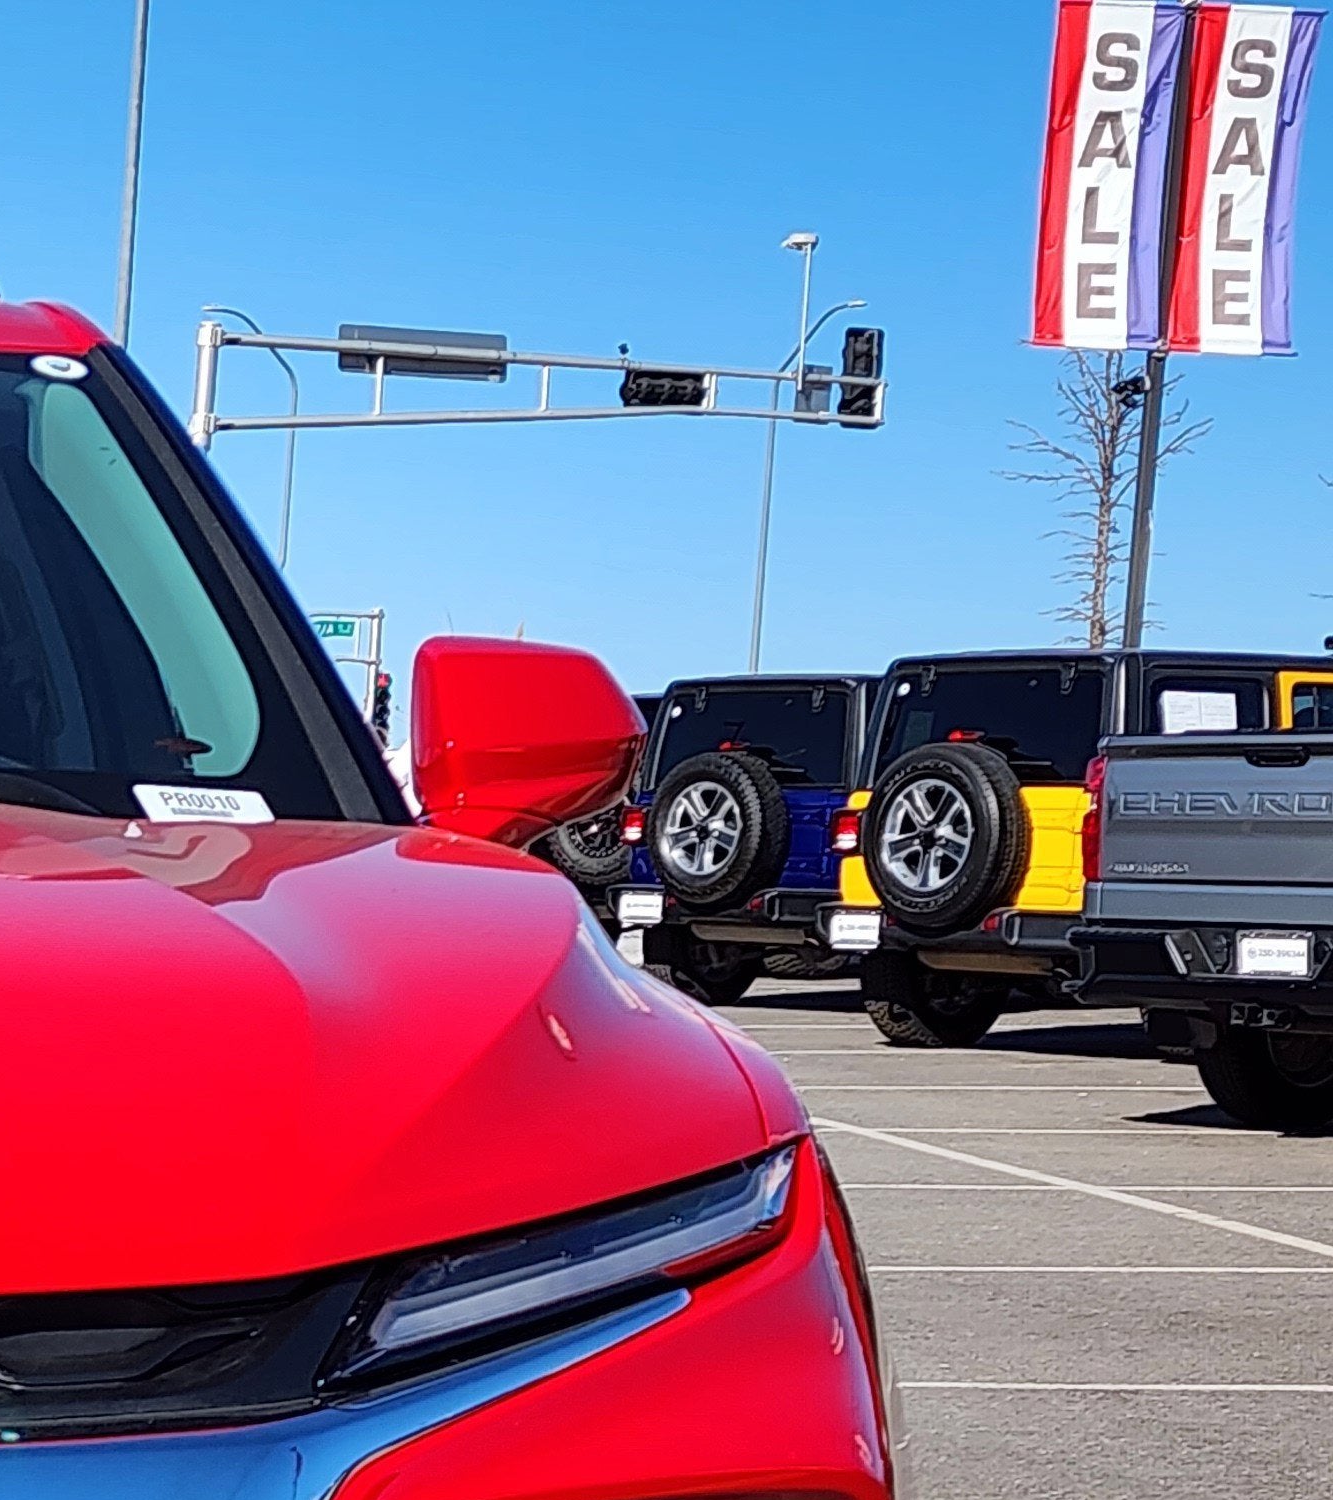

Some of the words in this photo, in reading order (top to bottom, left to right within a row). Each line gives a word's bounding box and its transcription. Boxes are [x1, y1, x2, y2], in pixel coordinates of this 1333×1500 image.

[1076, 32, 1141, 320] SALE
[1212, 39, 1277, 326] SALE
[158, 791, 241, 811] PR0010
